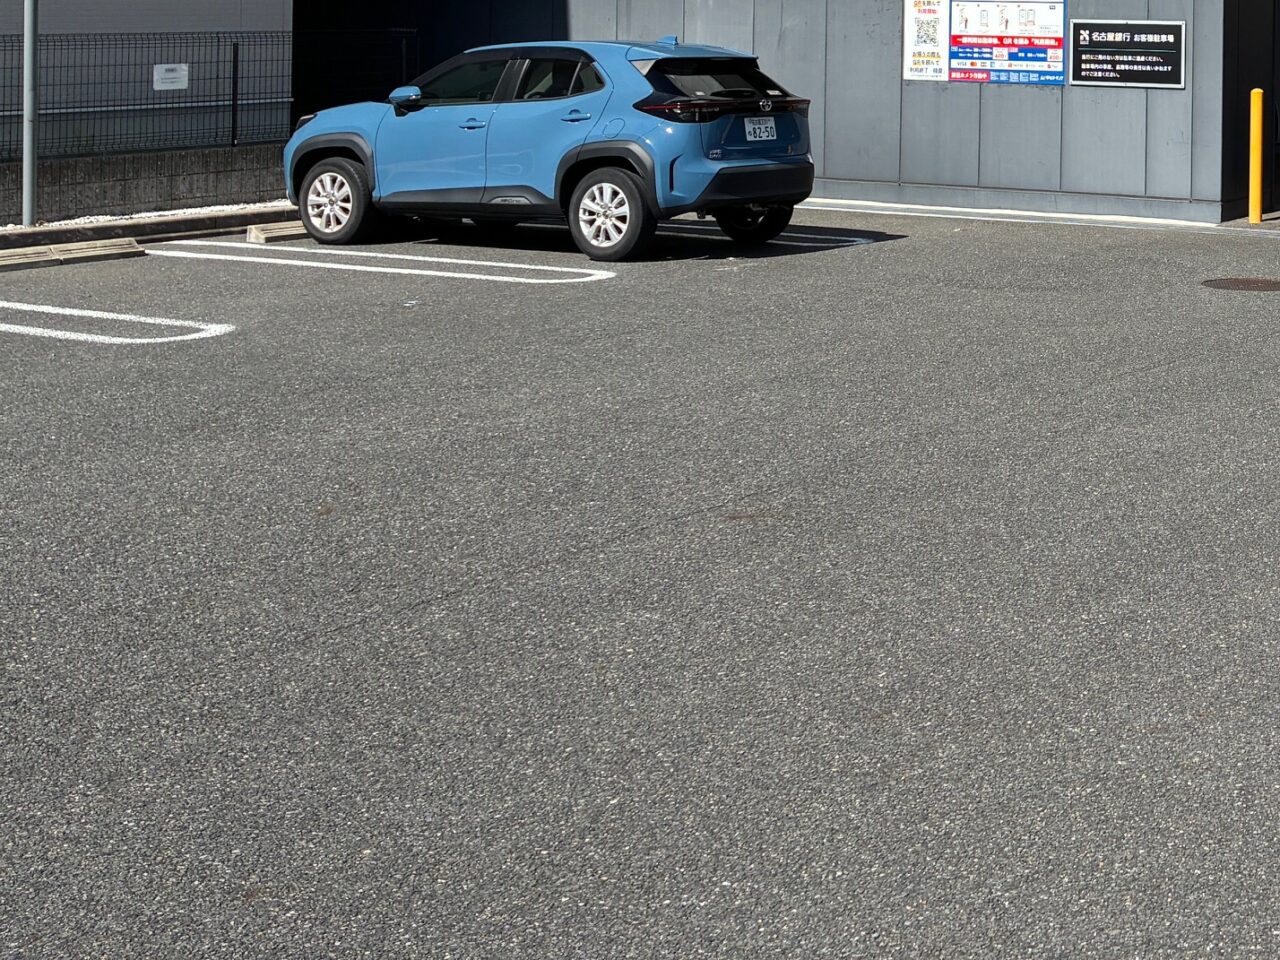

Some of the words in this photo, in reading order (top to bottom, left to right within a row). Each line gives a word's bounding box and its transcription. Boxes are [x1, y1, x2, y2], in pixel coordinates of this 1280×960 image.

[1091, 31, 1131, 42] 名古屋銀行
[1133, 34, 1175, 43] お客様駐車場
